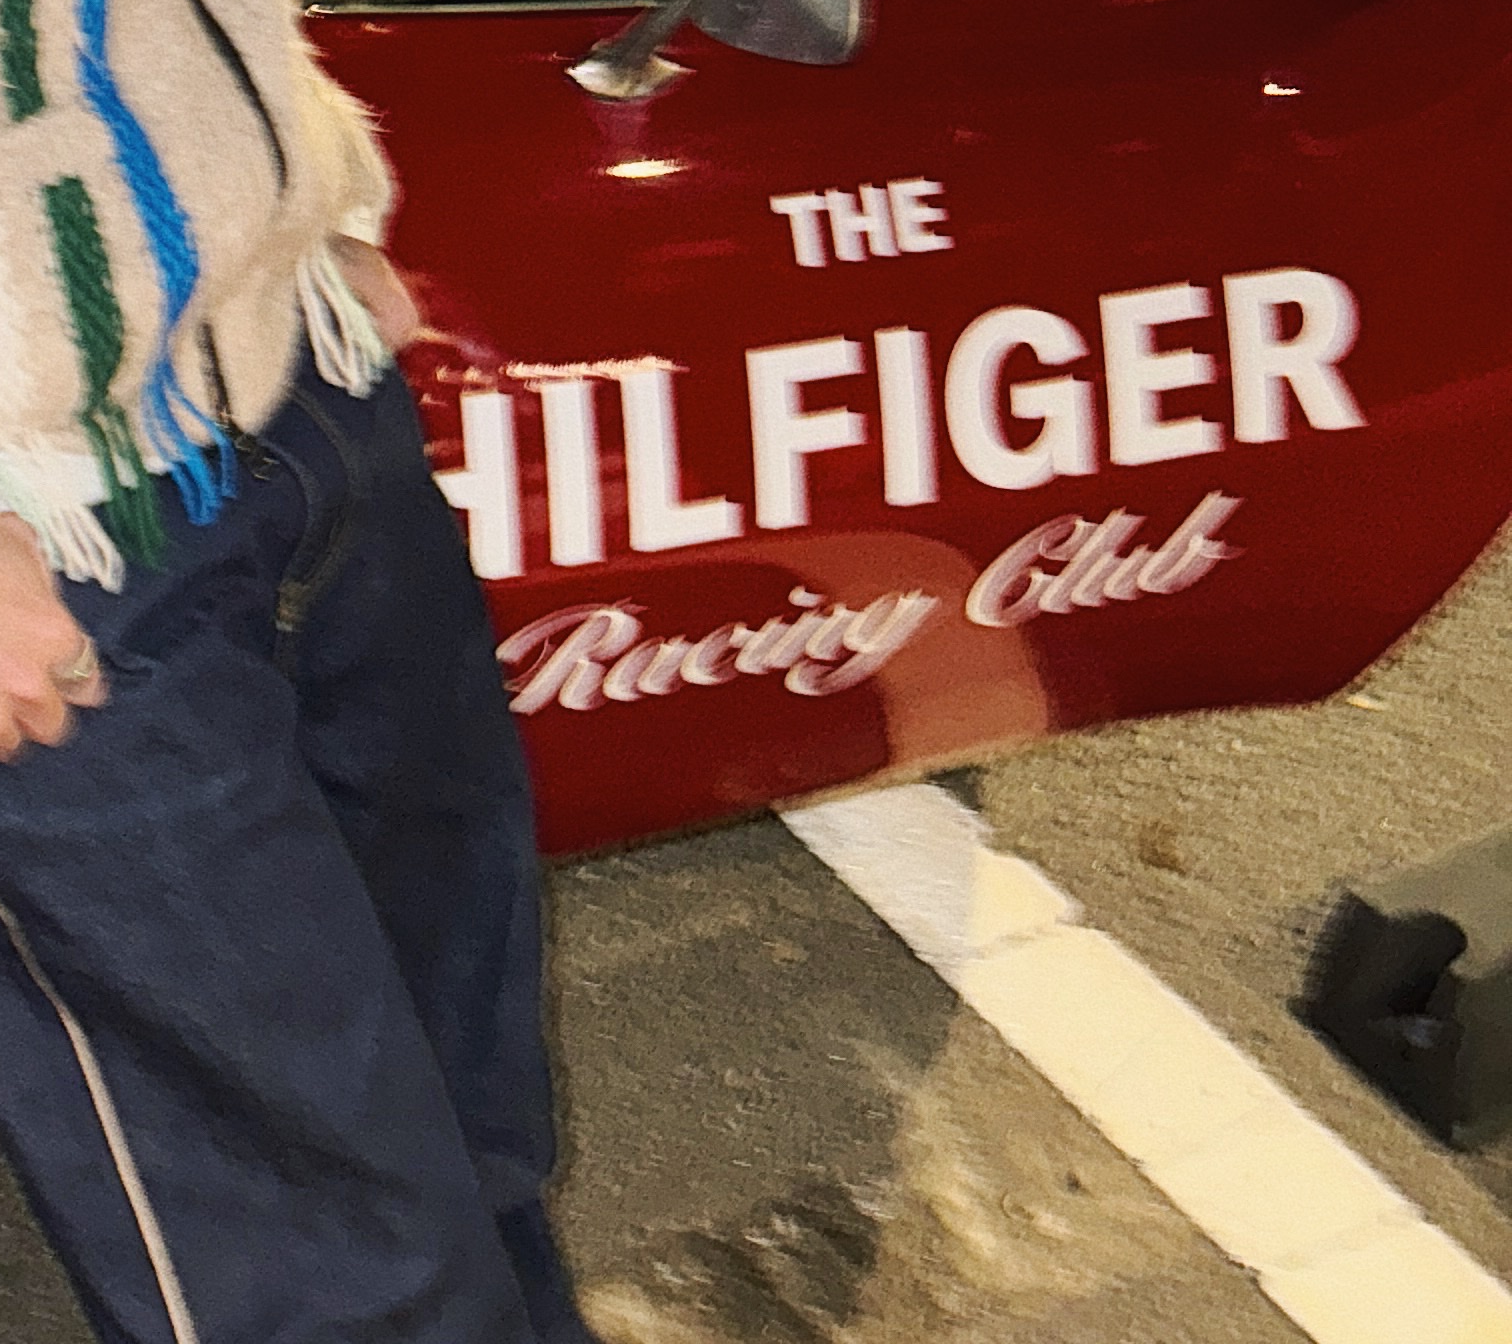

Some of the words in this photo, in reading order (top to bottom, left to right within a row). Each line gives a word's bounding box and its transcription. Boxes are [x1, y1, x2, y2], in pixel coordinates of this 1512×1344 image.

[770, 177, 954, 267] THE
[496, 585, 943, 714] Racing
[964, 489, 1245, 630] Club
